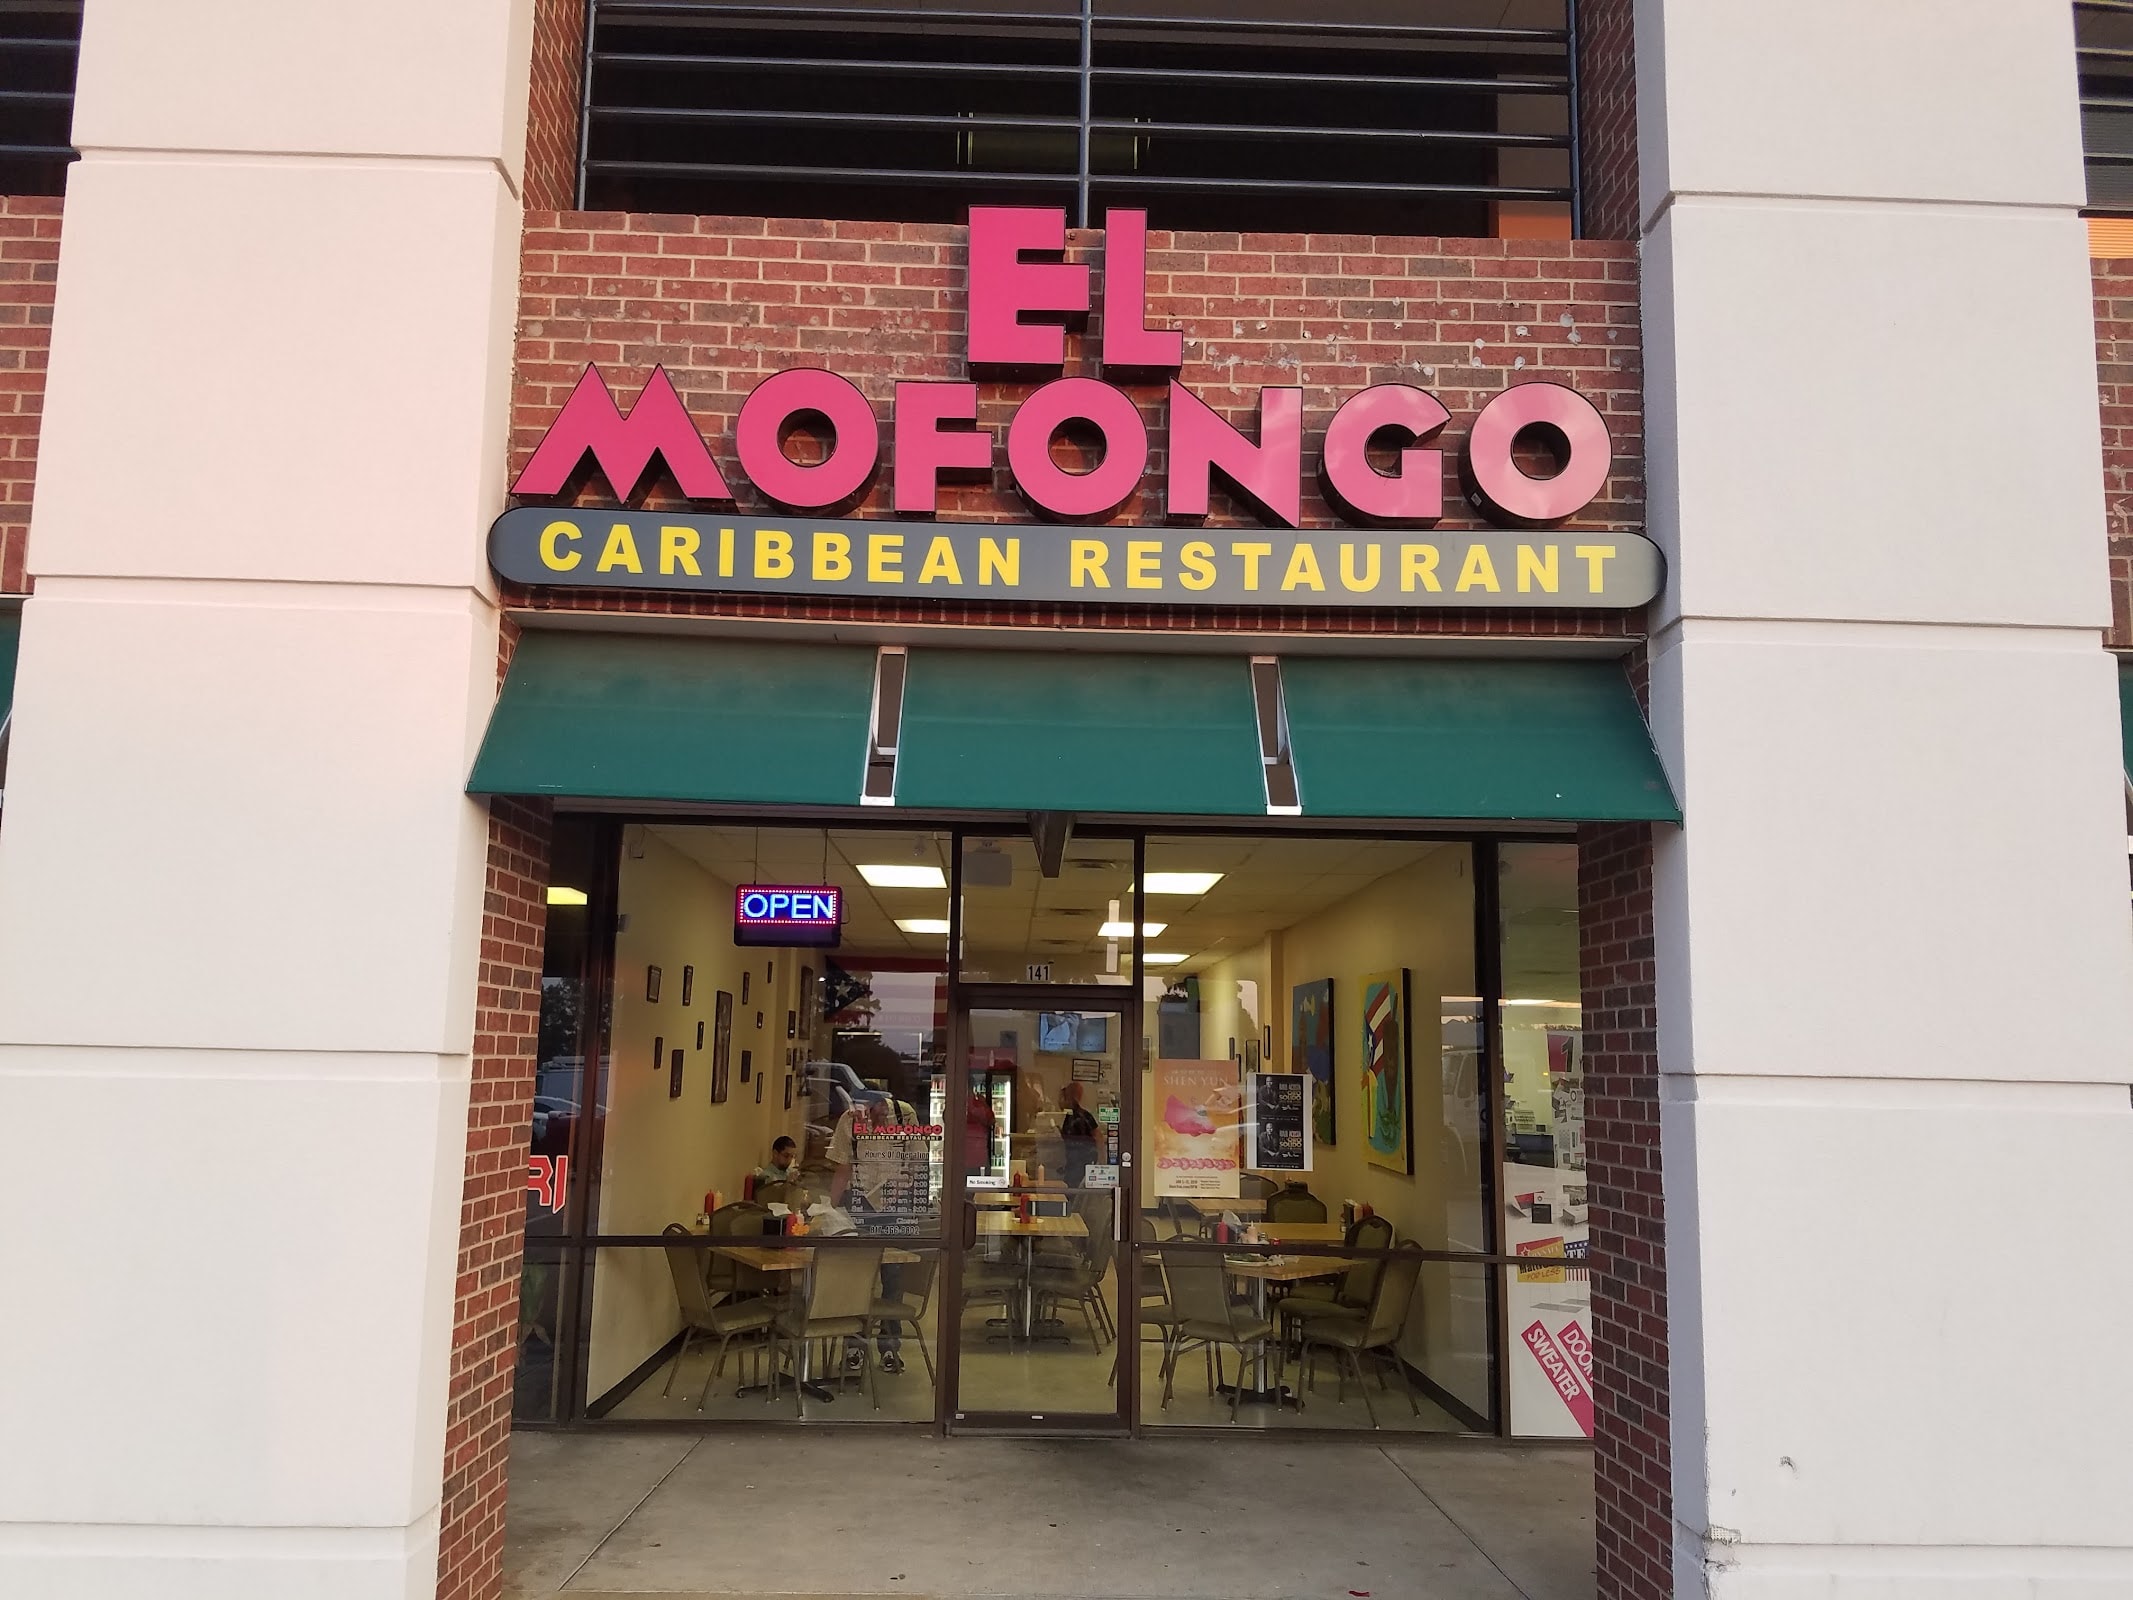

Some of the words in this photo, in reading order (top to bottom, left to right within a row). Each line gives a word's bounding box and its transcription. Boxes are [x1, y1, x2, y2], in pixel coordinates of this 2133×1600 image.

[968, 205, 1183, 368] EL
[510, 362, 1612, 527] MOFONGO
[539, 521, 1021, 586] CARIBBEAN
[1070, 540, 1617, 594] RESTAURANT
[743, 893, 834, 919] OPEN
[1028, 965, 1049, 981] 141
[1163, 1075, 1197, 1086] SHEN
[1200, 1075, 1229, 1086] YUN
[853, 1123, 869, 1134] EL
[873, 1124, 943, 1135] MOFONGO
[1528, 1328, 1580, 1401] SWEATER
